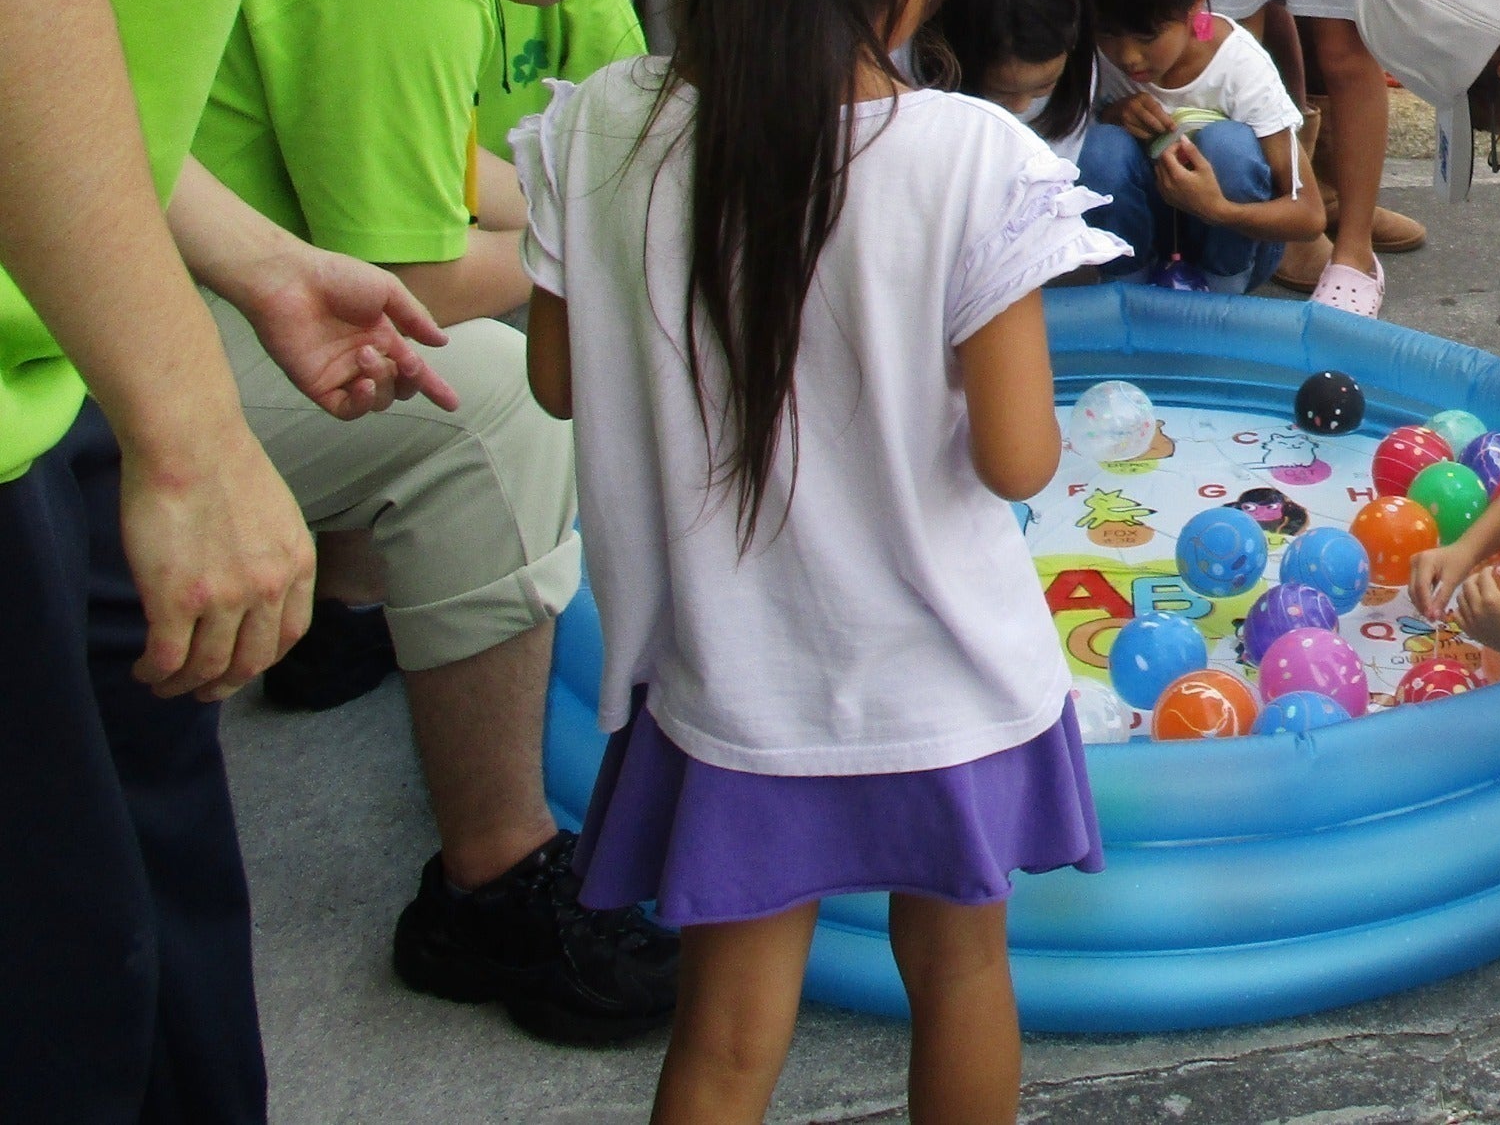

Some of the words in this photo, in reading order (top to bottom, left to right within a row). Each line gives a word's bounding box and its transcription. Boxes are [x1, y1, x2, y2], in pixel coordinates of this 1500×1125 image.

[1232, 432, 1259, 445] C
[1067, 484, 1089, 496] F
[1197, 484, 1228, 498] G
[1345, 486, 1371, 502] H
[1103, 529, 1138, 537] FOX
[1045, 569, 1135, 619] A
[1131, 575, 1214, 619] B
[1360, 621, 1396, 642] Q
